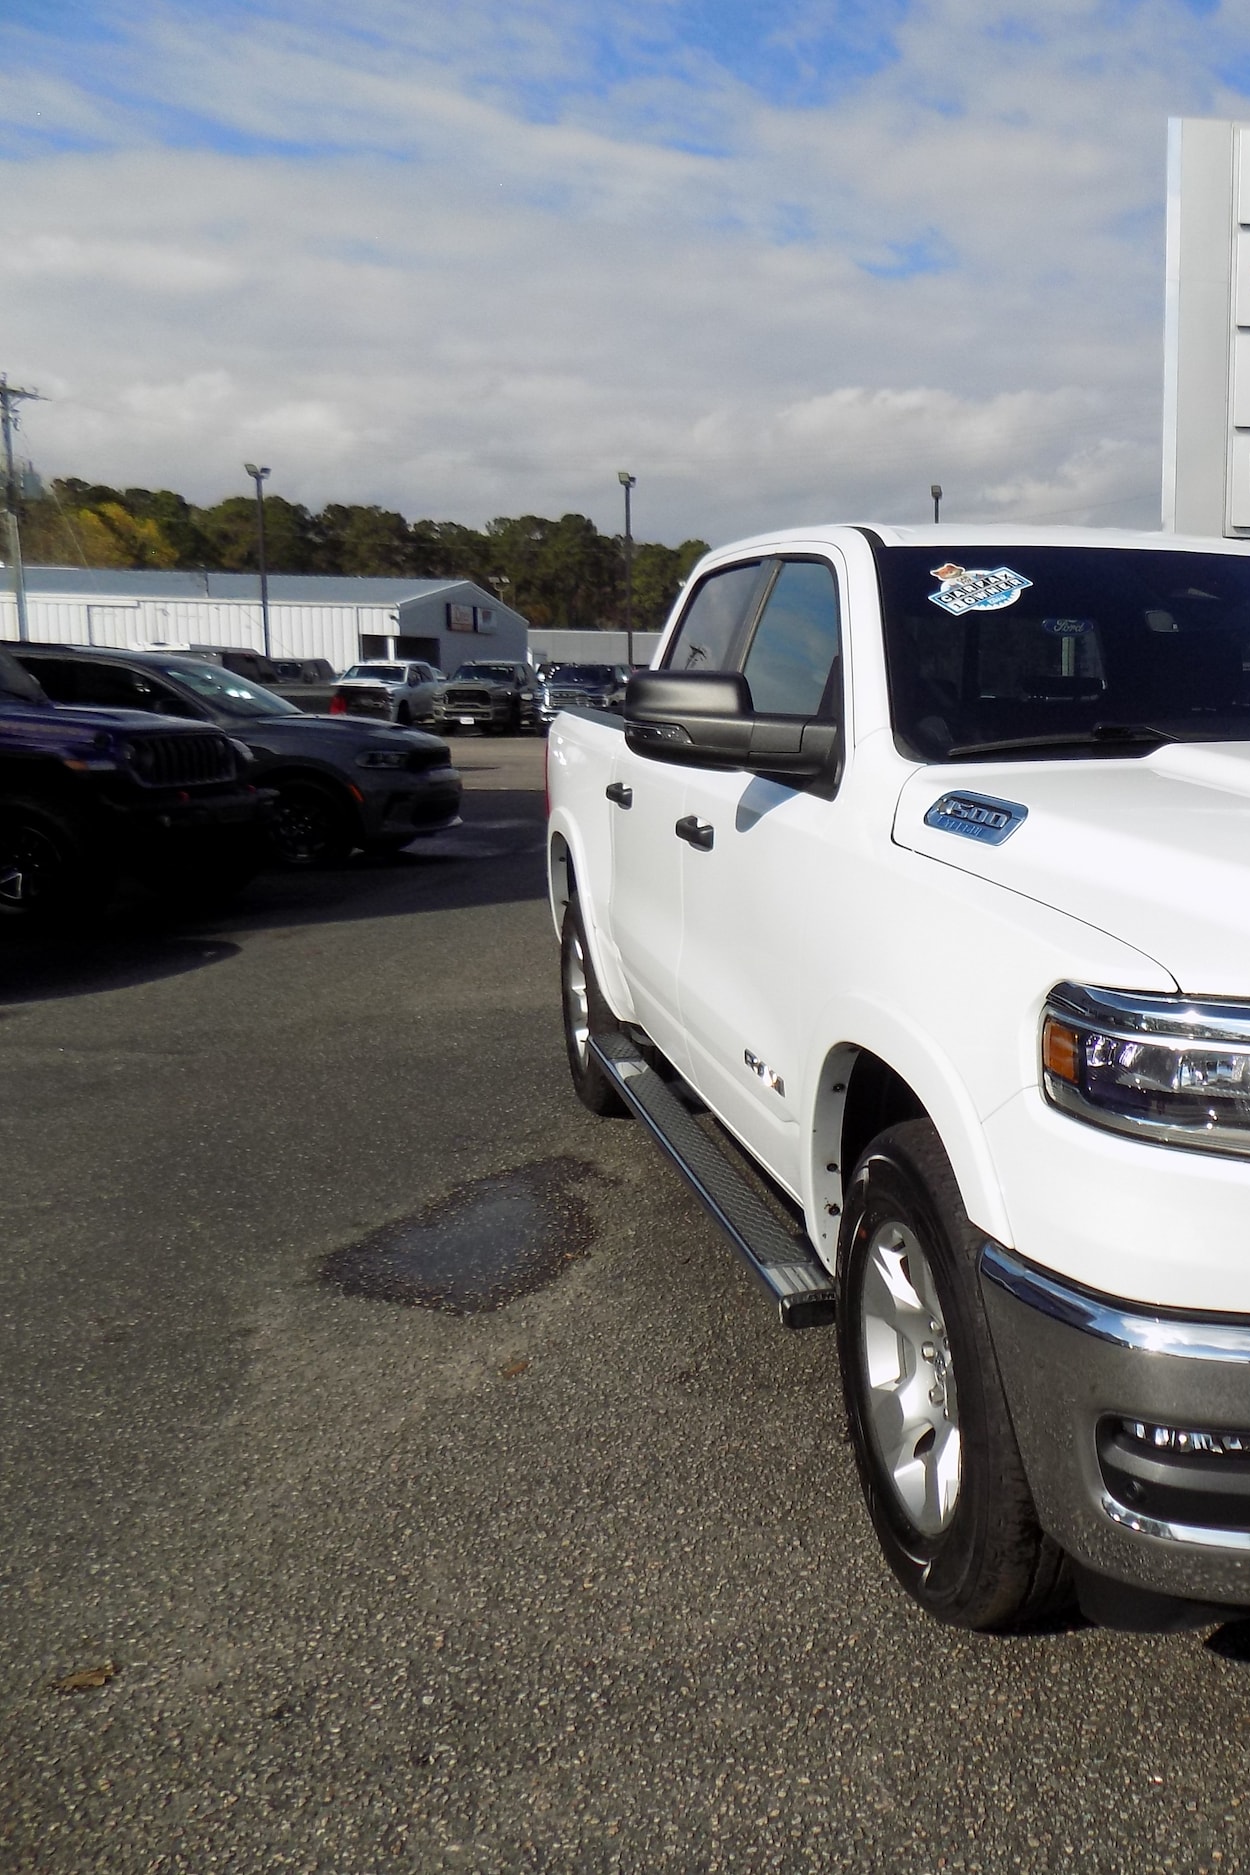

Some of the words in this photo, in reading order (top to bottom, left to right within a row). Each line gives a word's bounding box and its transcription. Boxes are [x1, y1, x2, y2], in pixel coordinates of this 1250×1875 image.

[939, 571, 1013, 604] CARFAX
[951, 602, 964, 611] 1
[963, 577, 1025, 606] OWNER
[1053, 618, 1085, 633] Ford
[744, 1048, 786, 1098] RAM
